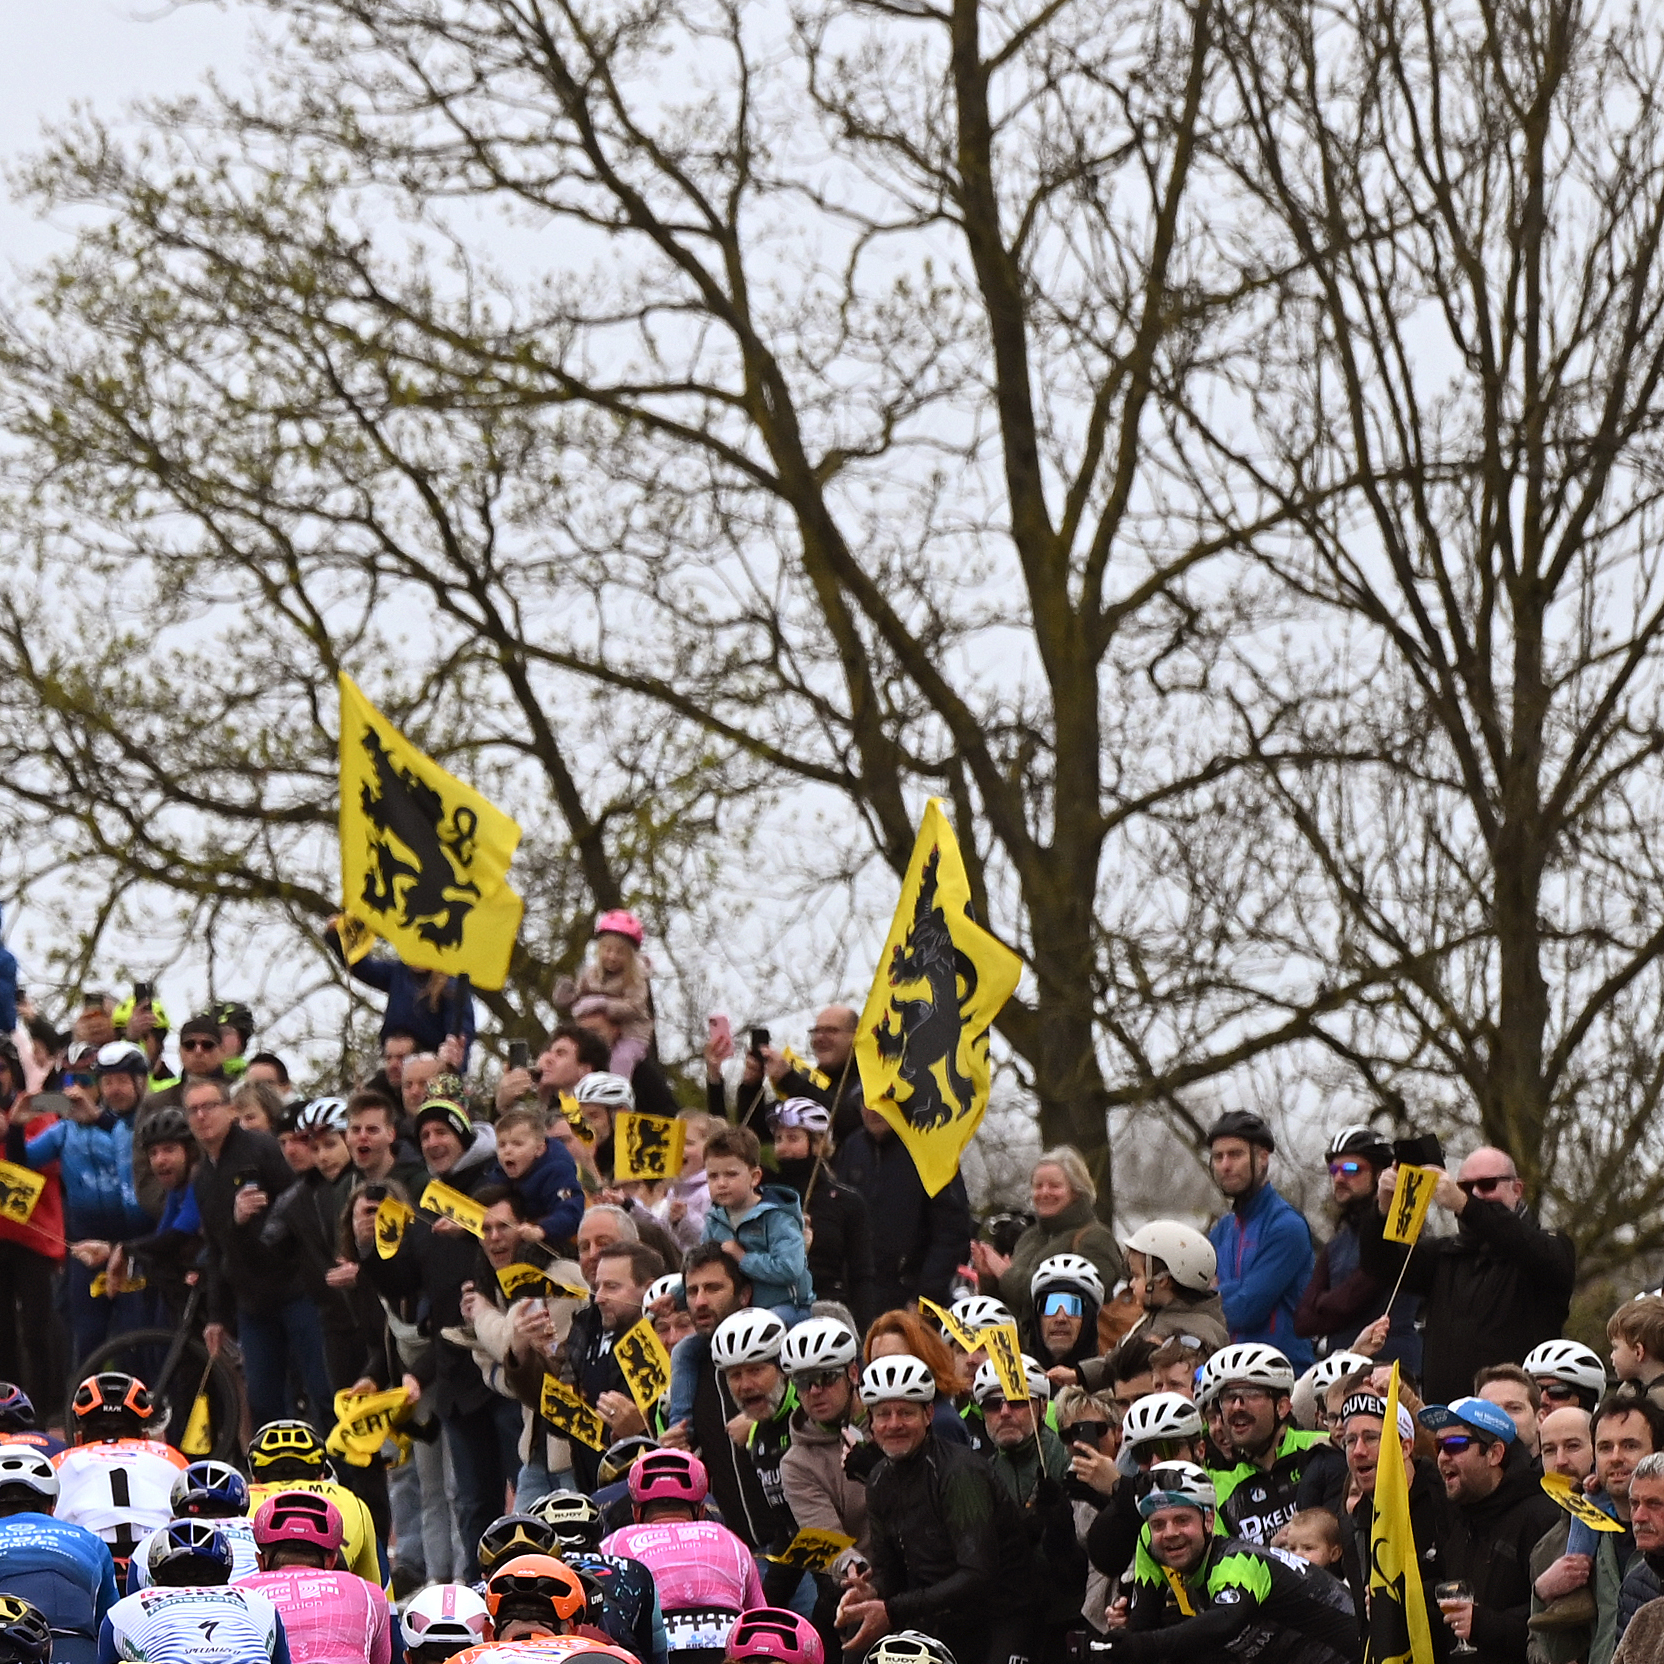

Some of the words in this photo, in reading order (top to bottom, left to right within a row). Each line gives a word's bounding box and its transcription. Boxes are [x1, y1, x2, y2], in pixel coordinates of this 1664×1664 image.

[103, 1404, 123, 1413] KASK
[1342, 1394, 1385, 1416] DUVEL
[885, 1656, 918, 1664] RUDY
